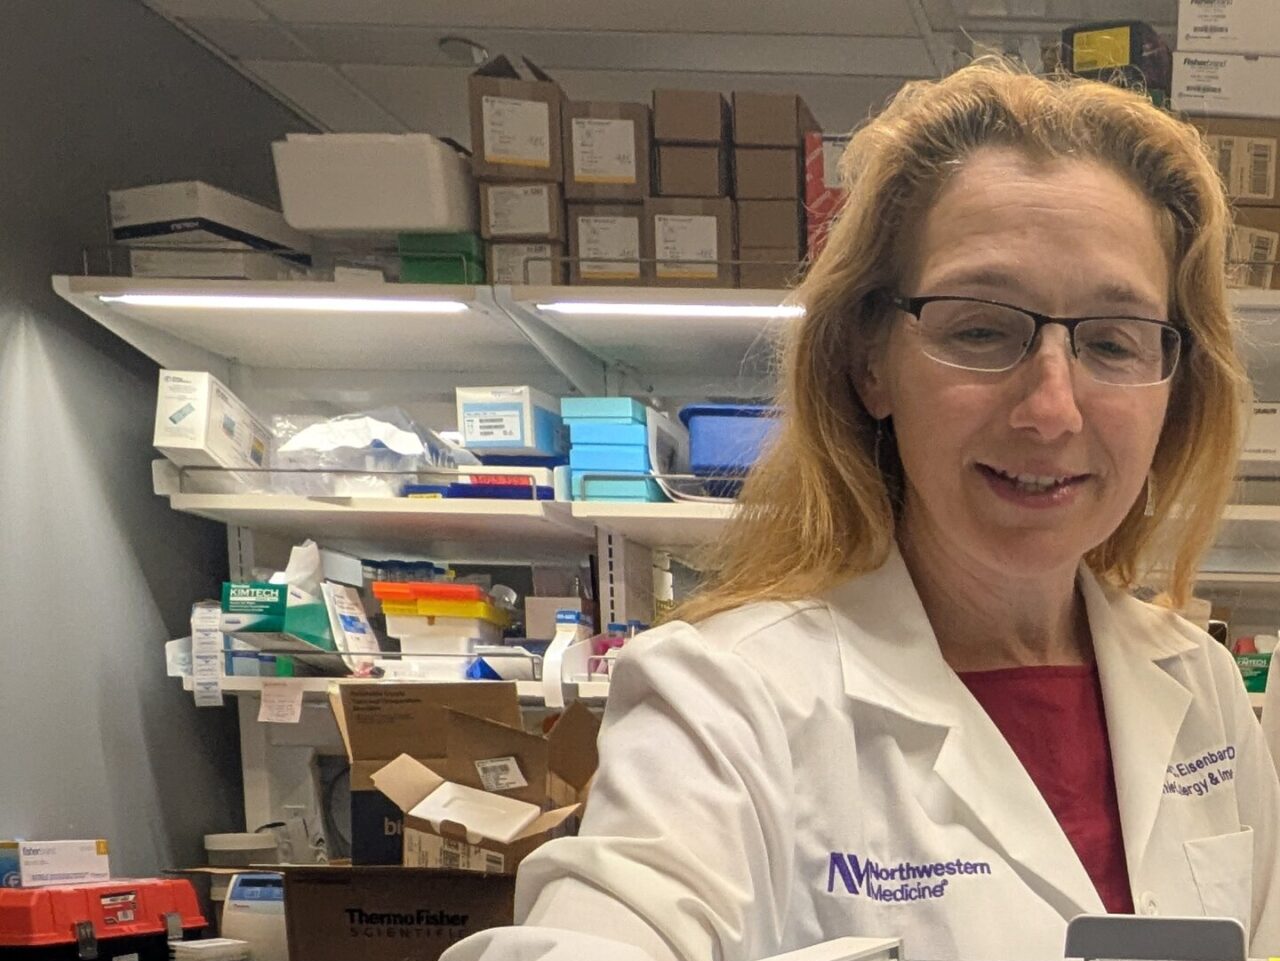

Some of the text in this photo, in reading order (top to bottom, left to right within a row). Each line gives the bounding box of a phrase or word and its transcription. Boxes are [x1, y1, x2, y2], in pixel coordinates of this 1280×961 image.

[230, 588, 279, 598] KIMTECH
[1207, 772, 1220, 785] &
[870, 858, 992, 881] Northwestern
